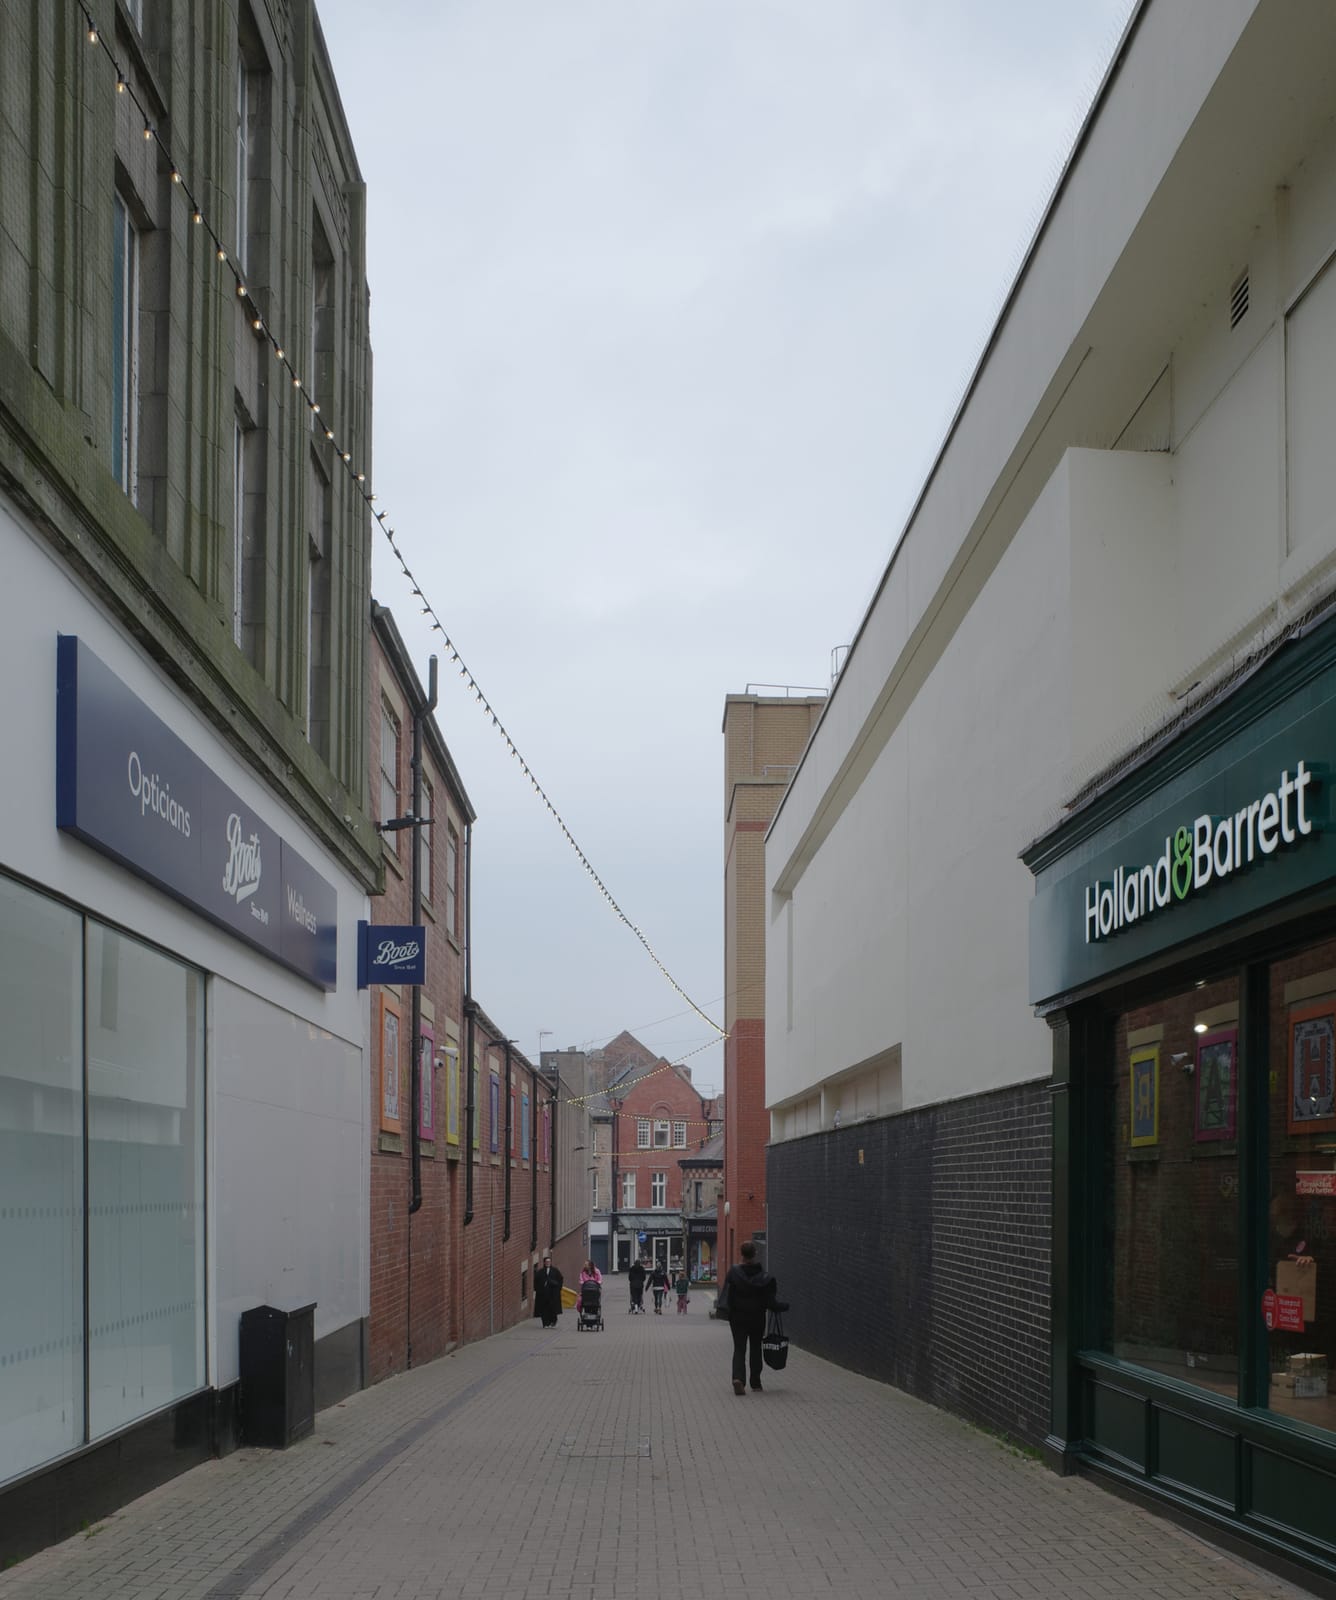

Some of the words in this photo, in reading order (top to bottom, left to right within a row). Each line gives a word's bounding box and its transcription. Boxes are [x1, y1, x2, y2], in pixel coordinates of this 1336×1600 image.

[128, 751, 191, 838] Opticians
[222, 812, 263, 904] Boots
[1085, 836, 1171, 944] Holland
[1194, 760, 1312, 890] Barrett
[287, 883, 317, 936] Wellness
[372, 939, 420, 966] Boots
